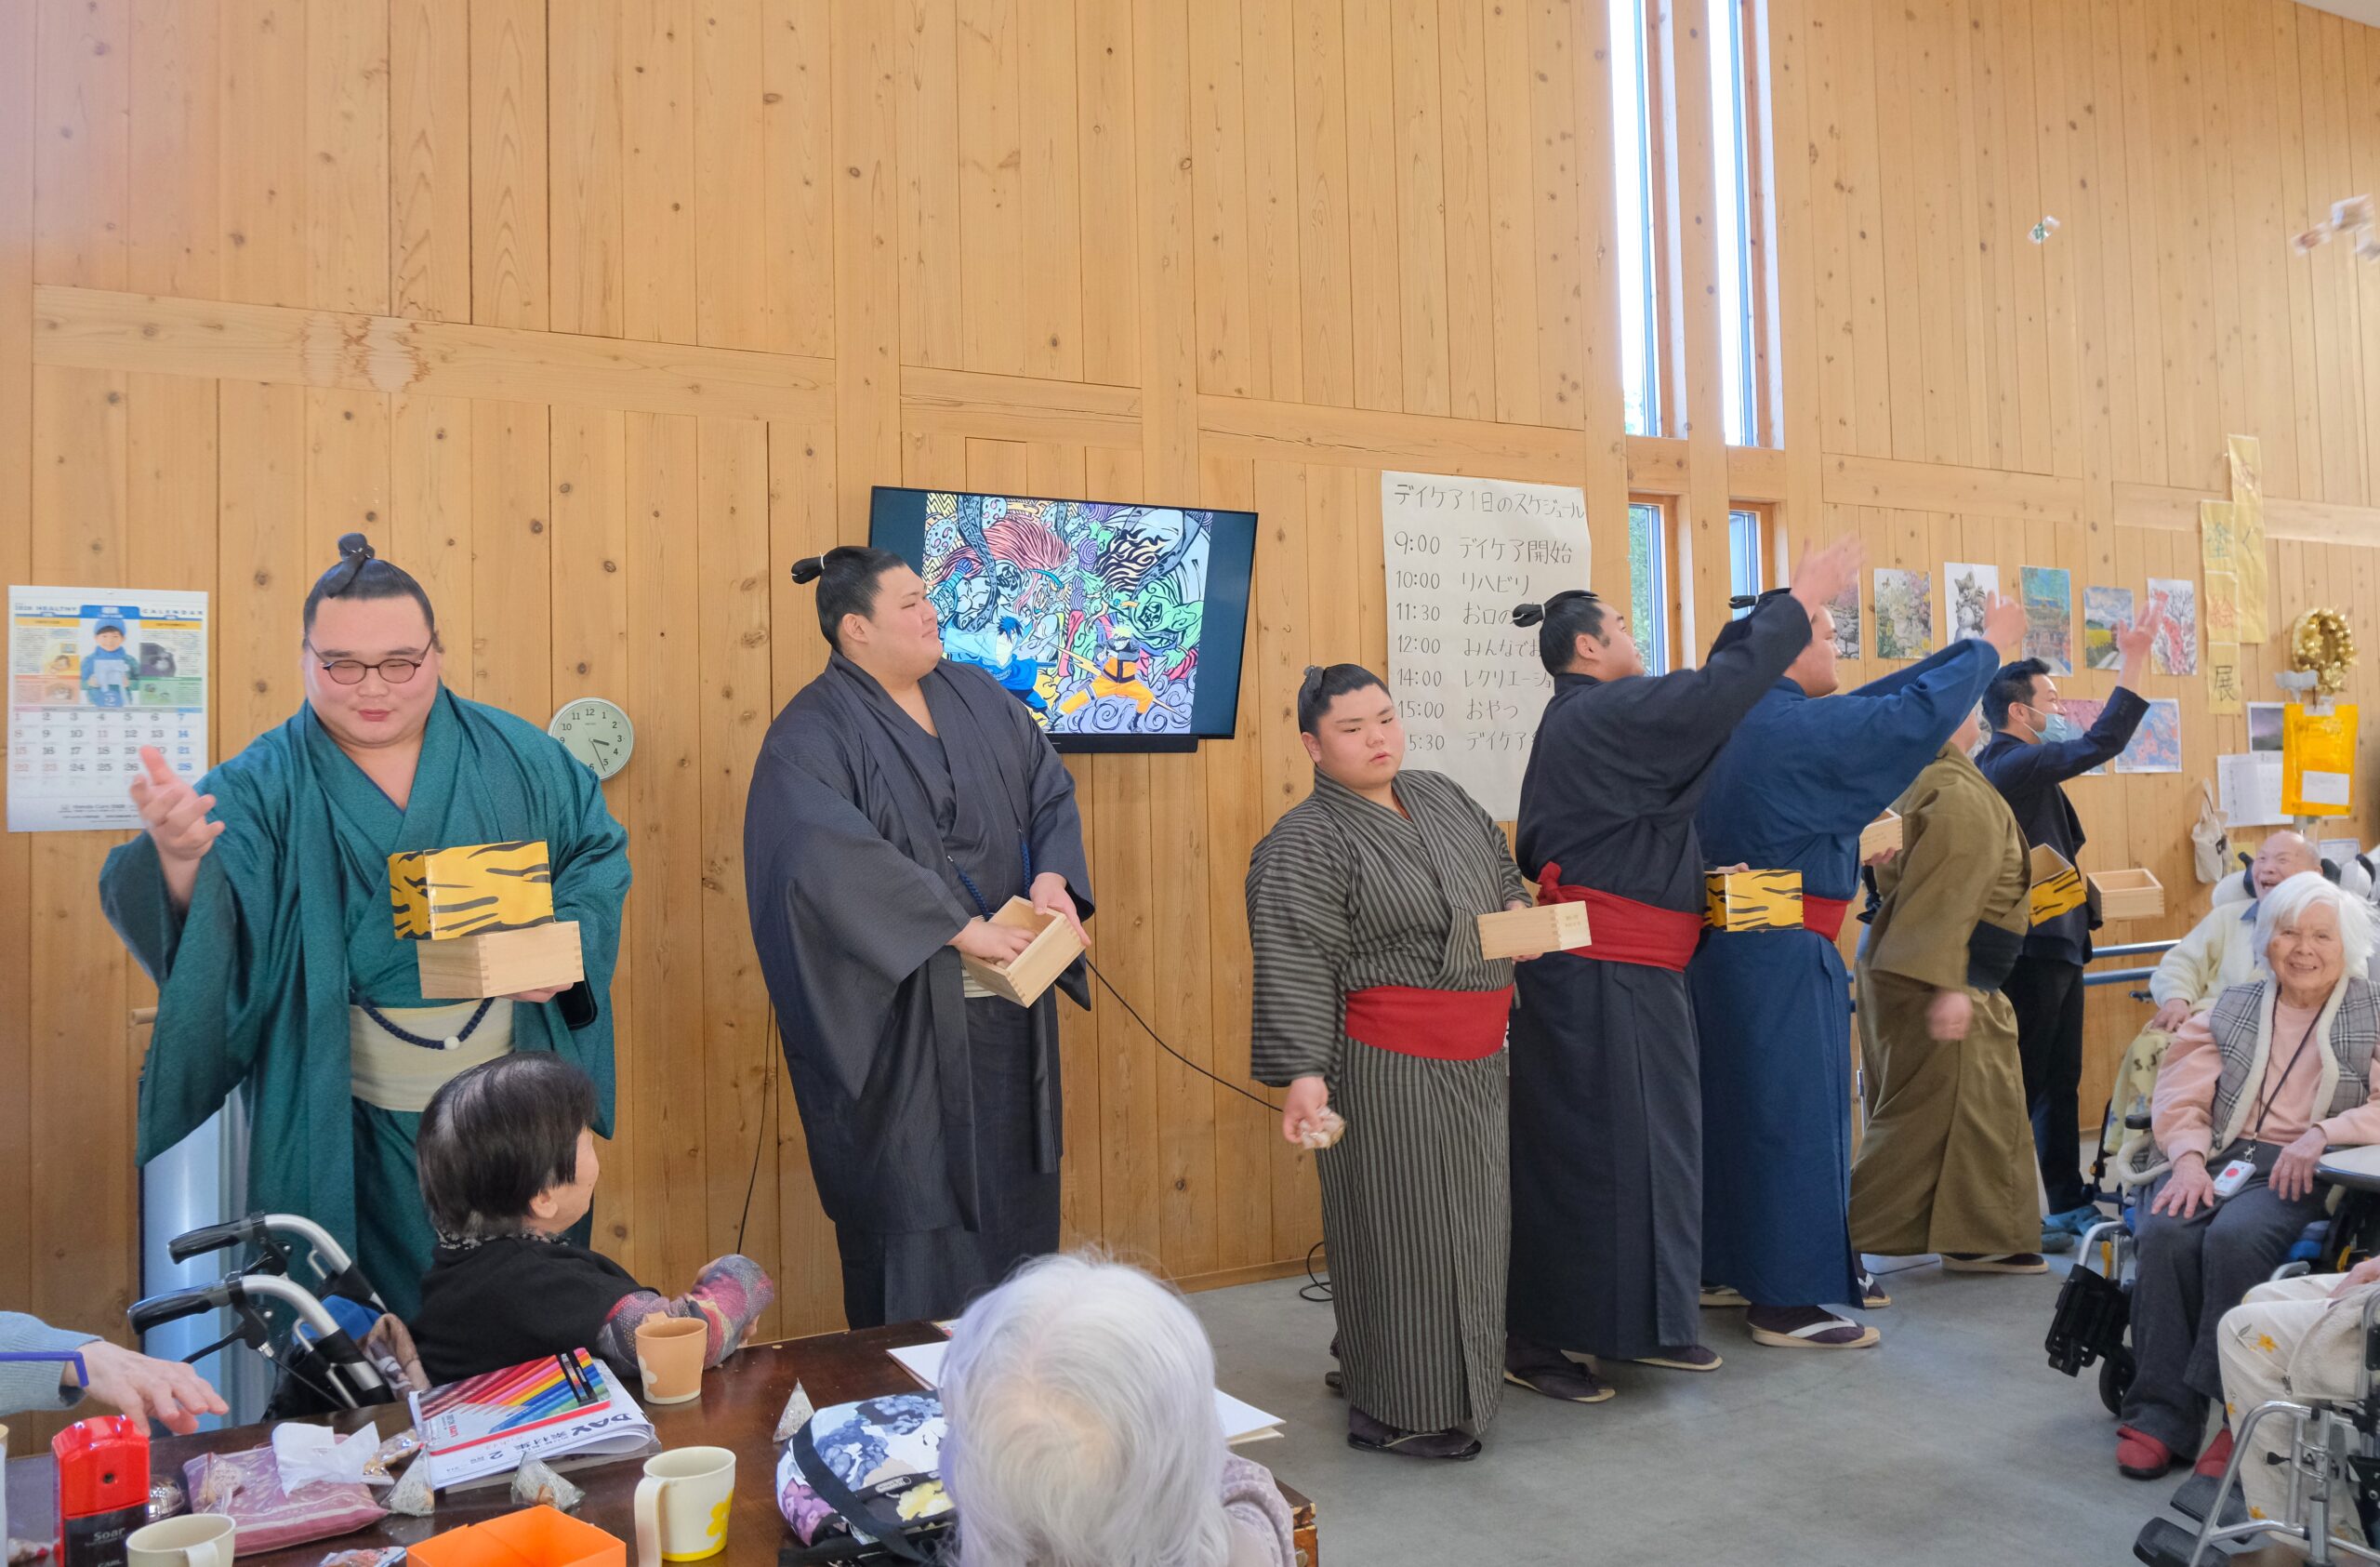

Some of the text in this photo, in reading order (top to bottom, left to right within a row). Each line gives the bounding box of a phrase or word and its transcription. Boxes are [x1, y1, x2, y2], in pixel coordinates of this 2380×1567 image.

[1395, 484, 1584, 518] デイケア1日のスケジュール
[1395, 531, 1572, 564] 9:00 デイケア開始
[1396, 570, 1529, 596] 10:00 リハビリ
[1396, 603, 1440, 621] 11:30
[1397, 634, 1440, 655] 12:00
[1397, 669, 1442, 687] 14:00
[1397, 698, 1518, 720] 15:00 おやつ
[70, 730, 84, 738] 10
[125, 730, 138, 738] 12
[151, 730, 164, 738] 13
[1409, 731, 1537, 751] 5:30 デイケア
[43, 747, 55, 755] 16
[70, 747, 82, 755] 17
[97, 747, 111, 755] 18
[125, 747, 137, 755] 19
[178, 747, 191, 755] 21
[70, 764, 86, 772] 24
[97, 764, 112, 772] 25
[124, 764, 139, 772] 26
[94, 1527, 126, 1541] Soar
